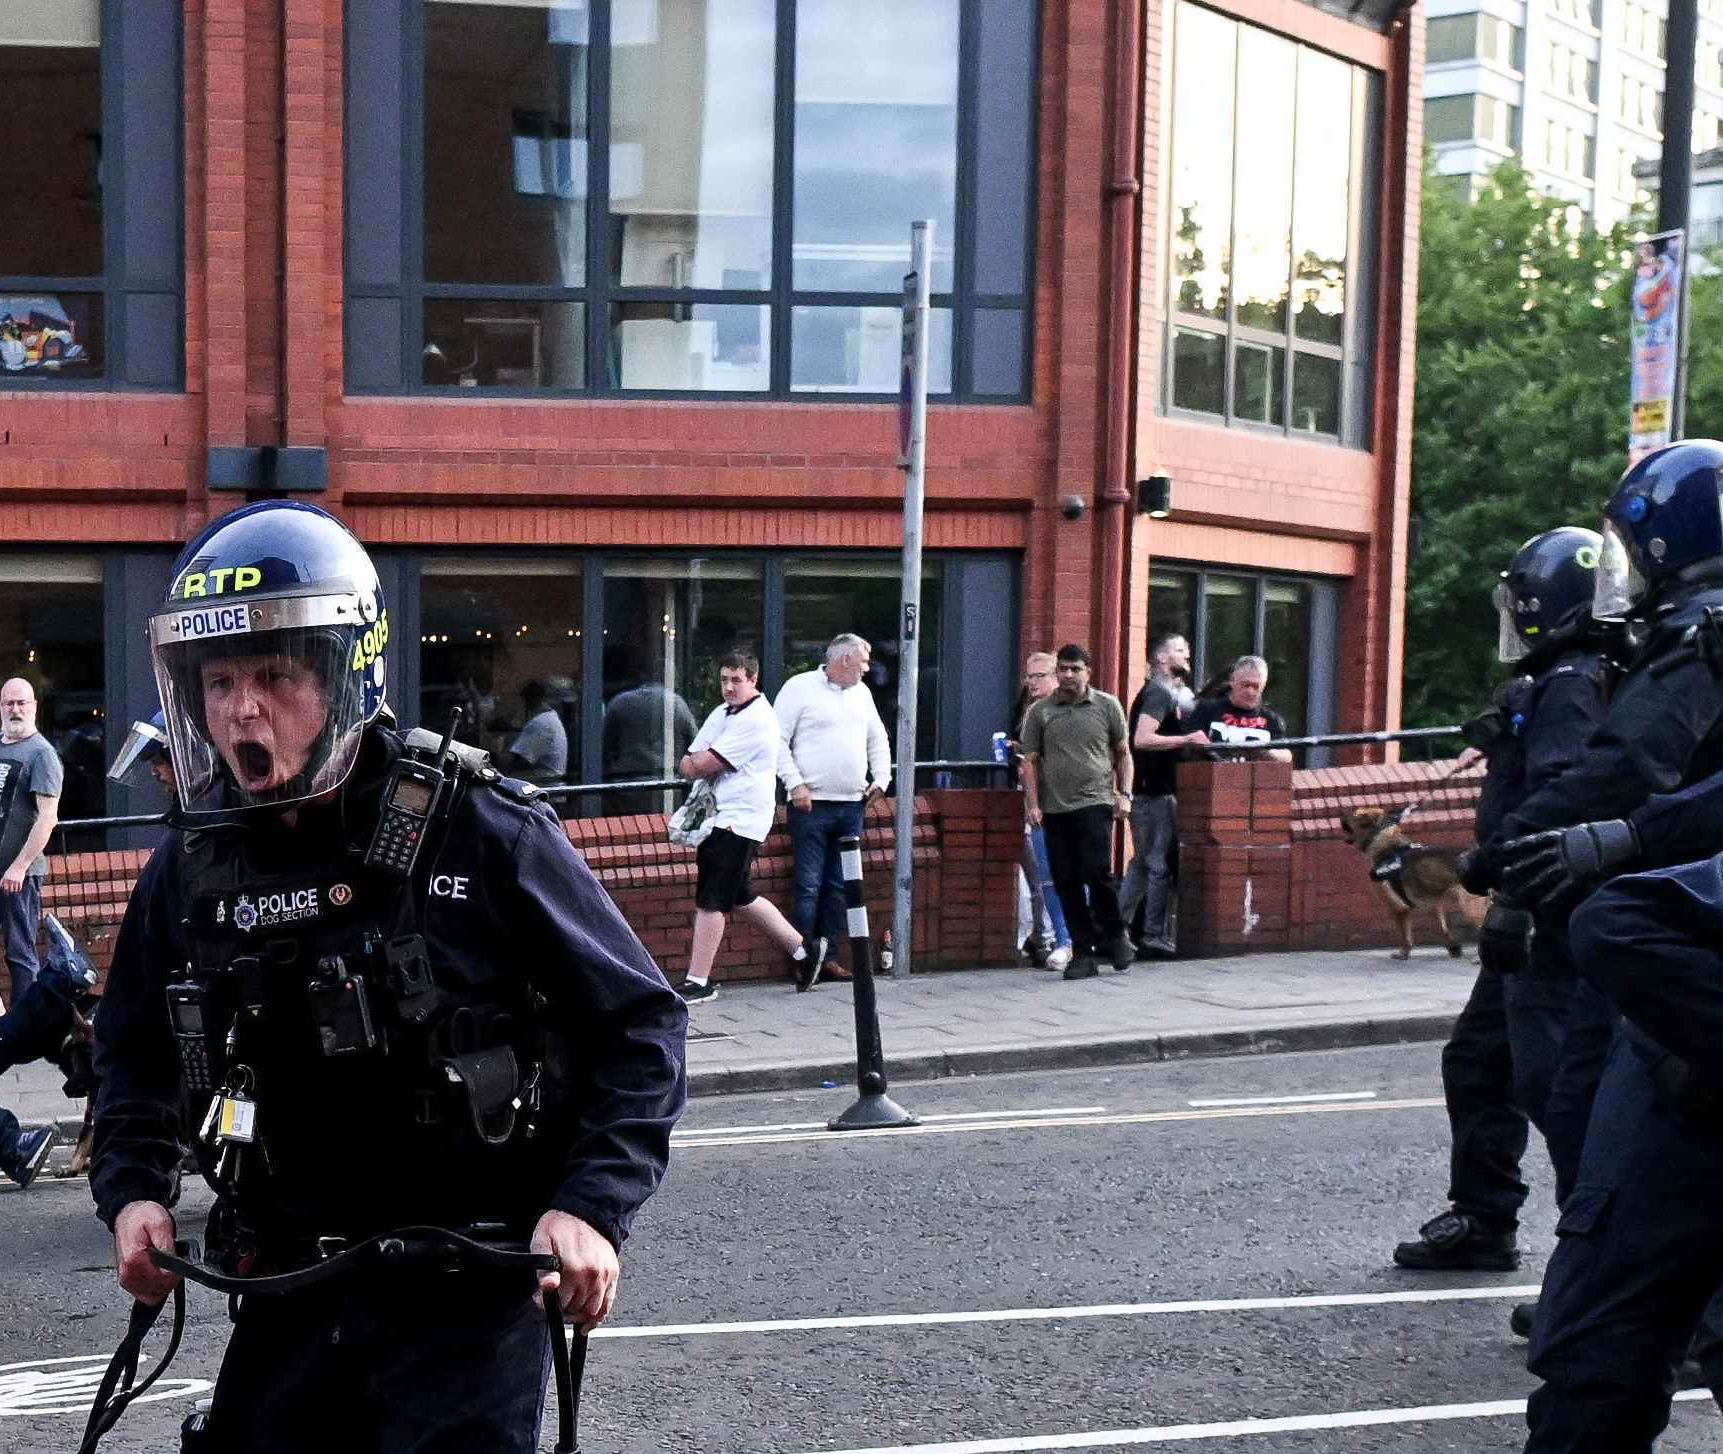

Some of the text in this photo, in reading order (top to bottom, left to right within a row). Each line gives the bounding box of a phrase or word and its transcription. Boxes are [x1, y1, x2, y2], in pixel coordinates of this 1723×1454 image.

[181, 608, 246, 637] POLICE
[353, 608, 388, 671] 4905
[258, 888, 318, 916] POLICE
[260, 906, 319, 926] DOG SECTION
